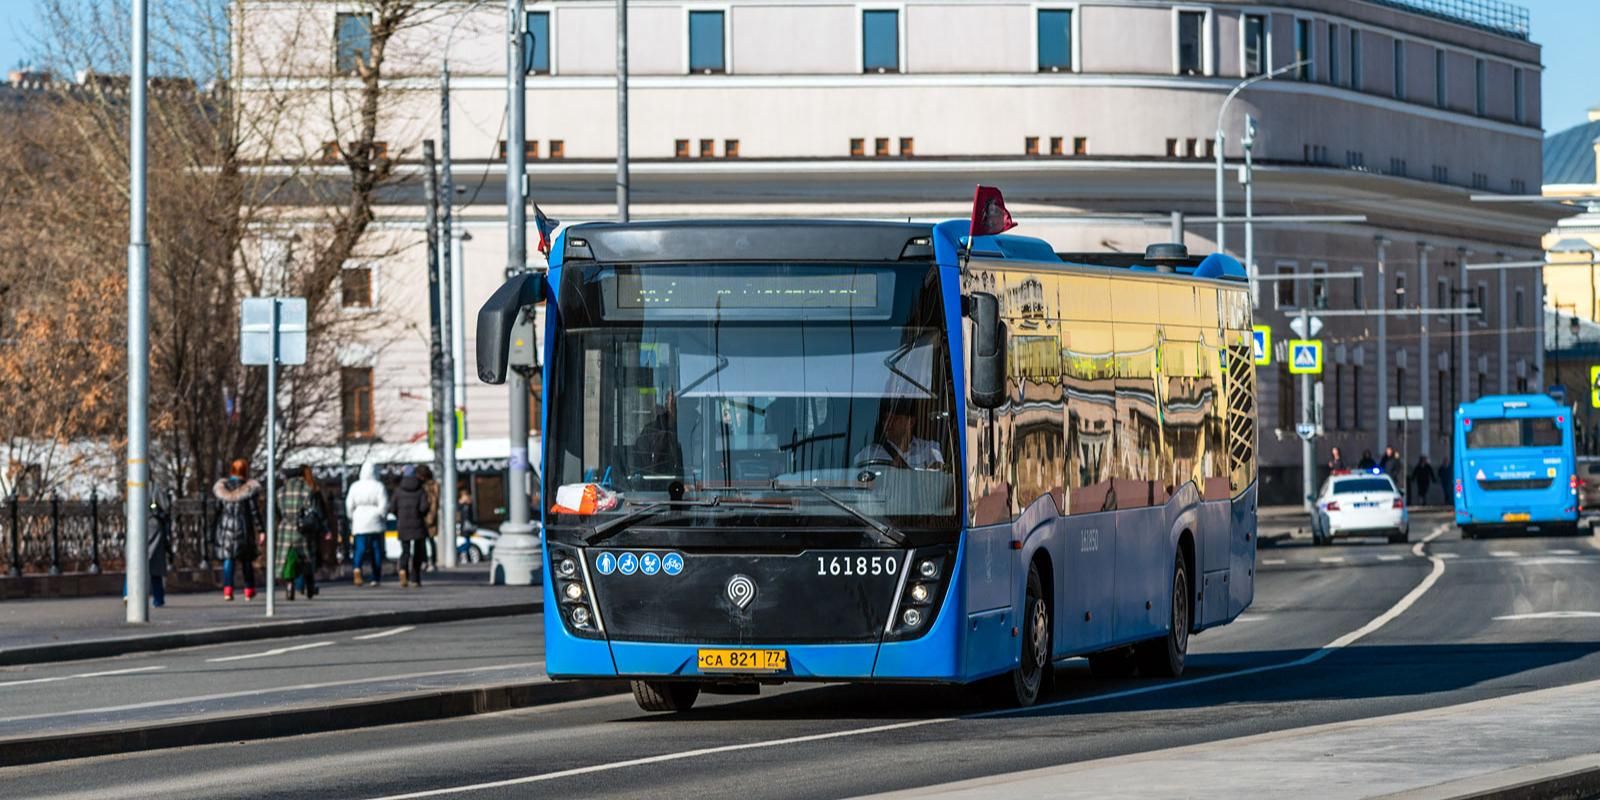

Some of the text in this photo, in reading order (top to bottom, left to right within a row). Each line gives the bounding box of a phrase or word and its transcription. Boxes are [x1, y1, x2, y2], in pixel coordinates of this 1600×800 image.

[817, 556, 897, 576] 161850
[730, 652, 757, 667] 821
[766, 651, 780, 663] 77
